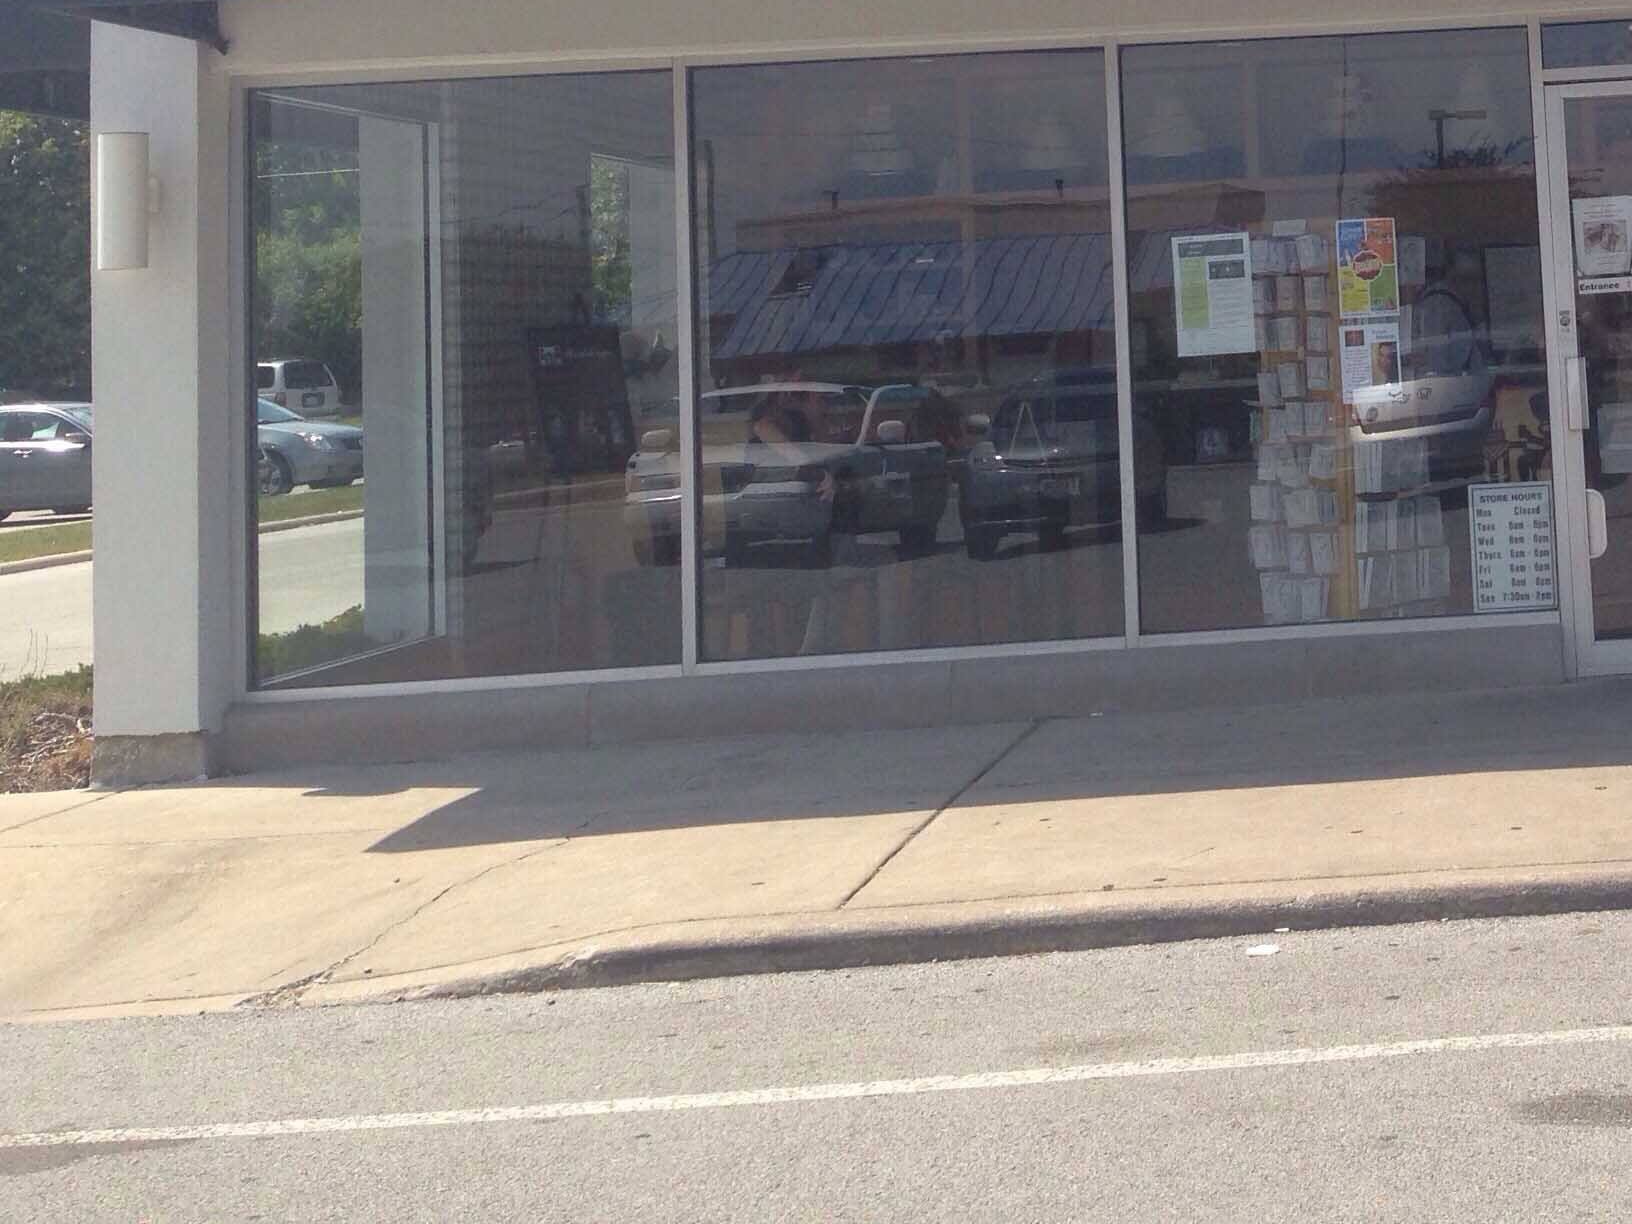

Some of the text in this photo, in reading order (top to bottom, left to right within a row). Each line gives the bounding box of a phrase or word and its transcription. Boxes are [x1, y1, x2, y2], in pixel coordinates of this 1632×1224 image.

[1580, 281, 1620, 292] Entrance
[1480, 492, 1543, 504] STORE HOURS
[1514, 505, 1540, 516] Closed
